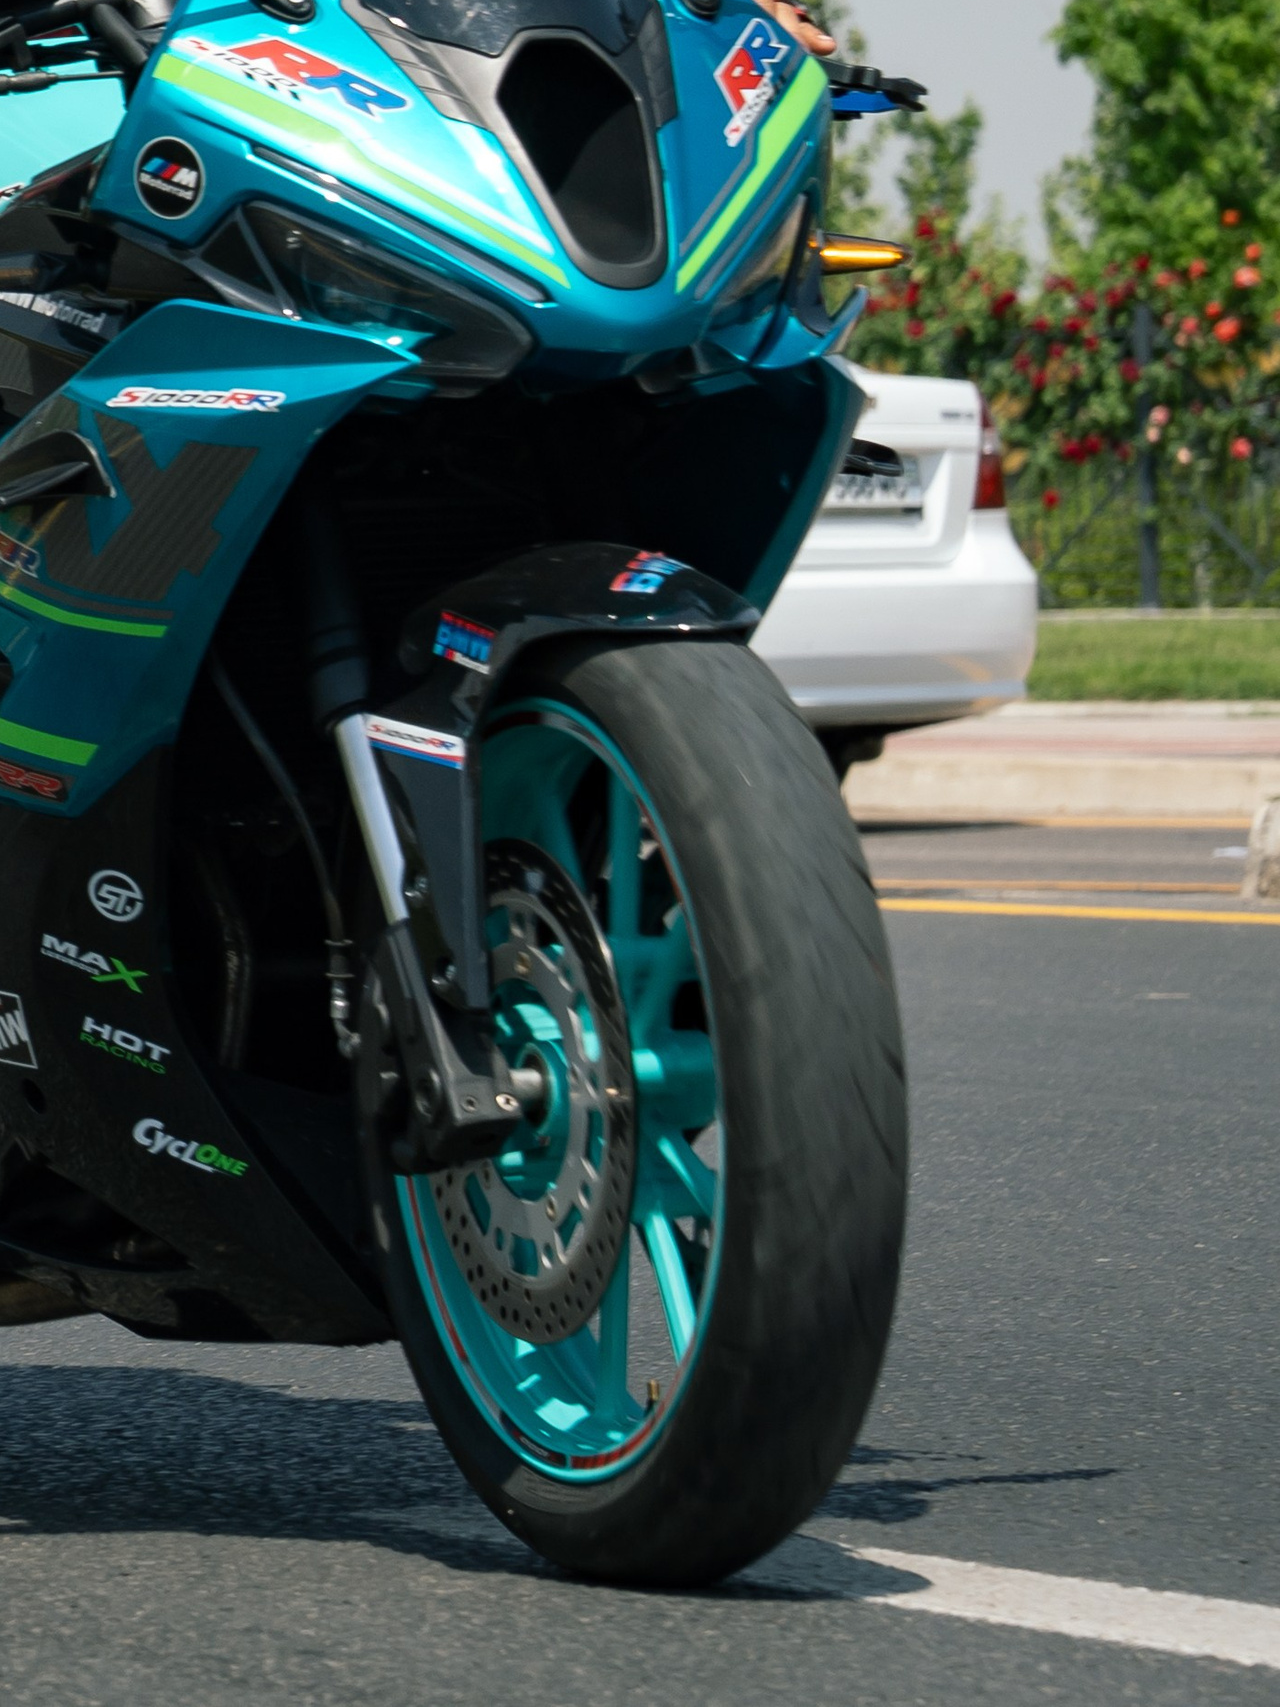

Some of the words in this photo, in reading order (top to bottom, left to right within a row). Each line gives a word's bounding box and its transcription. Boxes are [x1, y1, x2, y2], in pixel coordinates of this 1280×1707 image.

[228, 39, 408, 117] RR
[717, 19, 787, 112] RR
[112, 389, 281, 410] S1000RR
[41, 933, 149, 993] MAX
[79, 1032, 167, 1074] RACING
[82, 1016, 171, 1062] HOT
